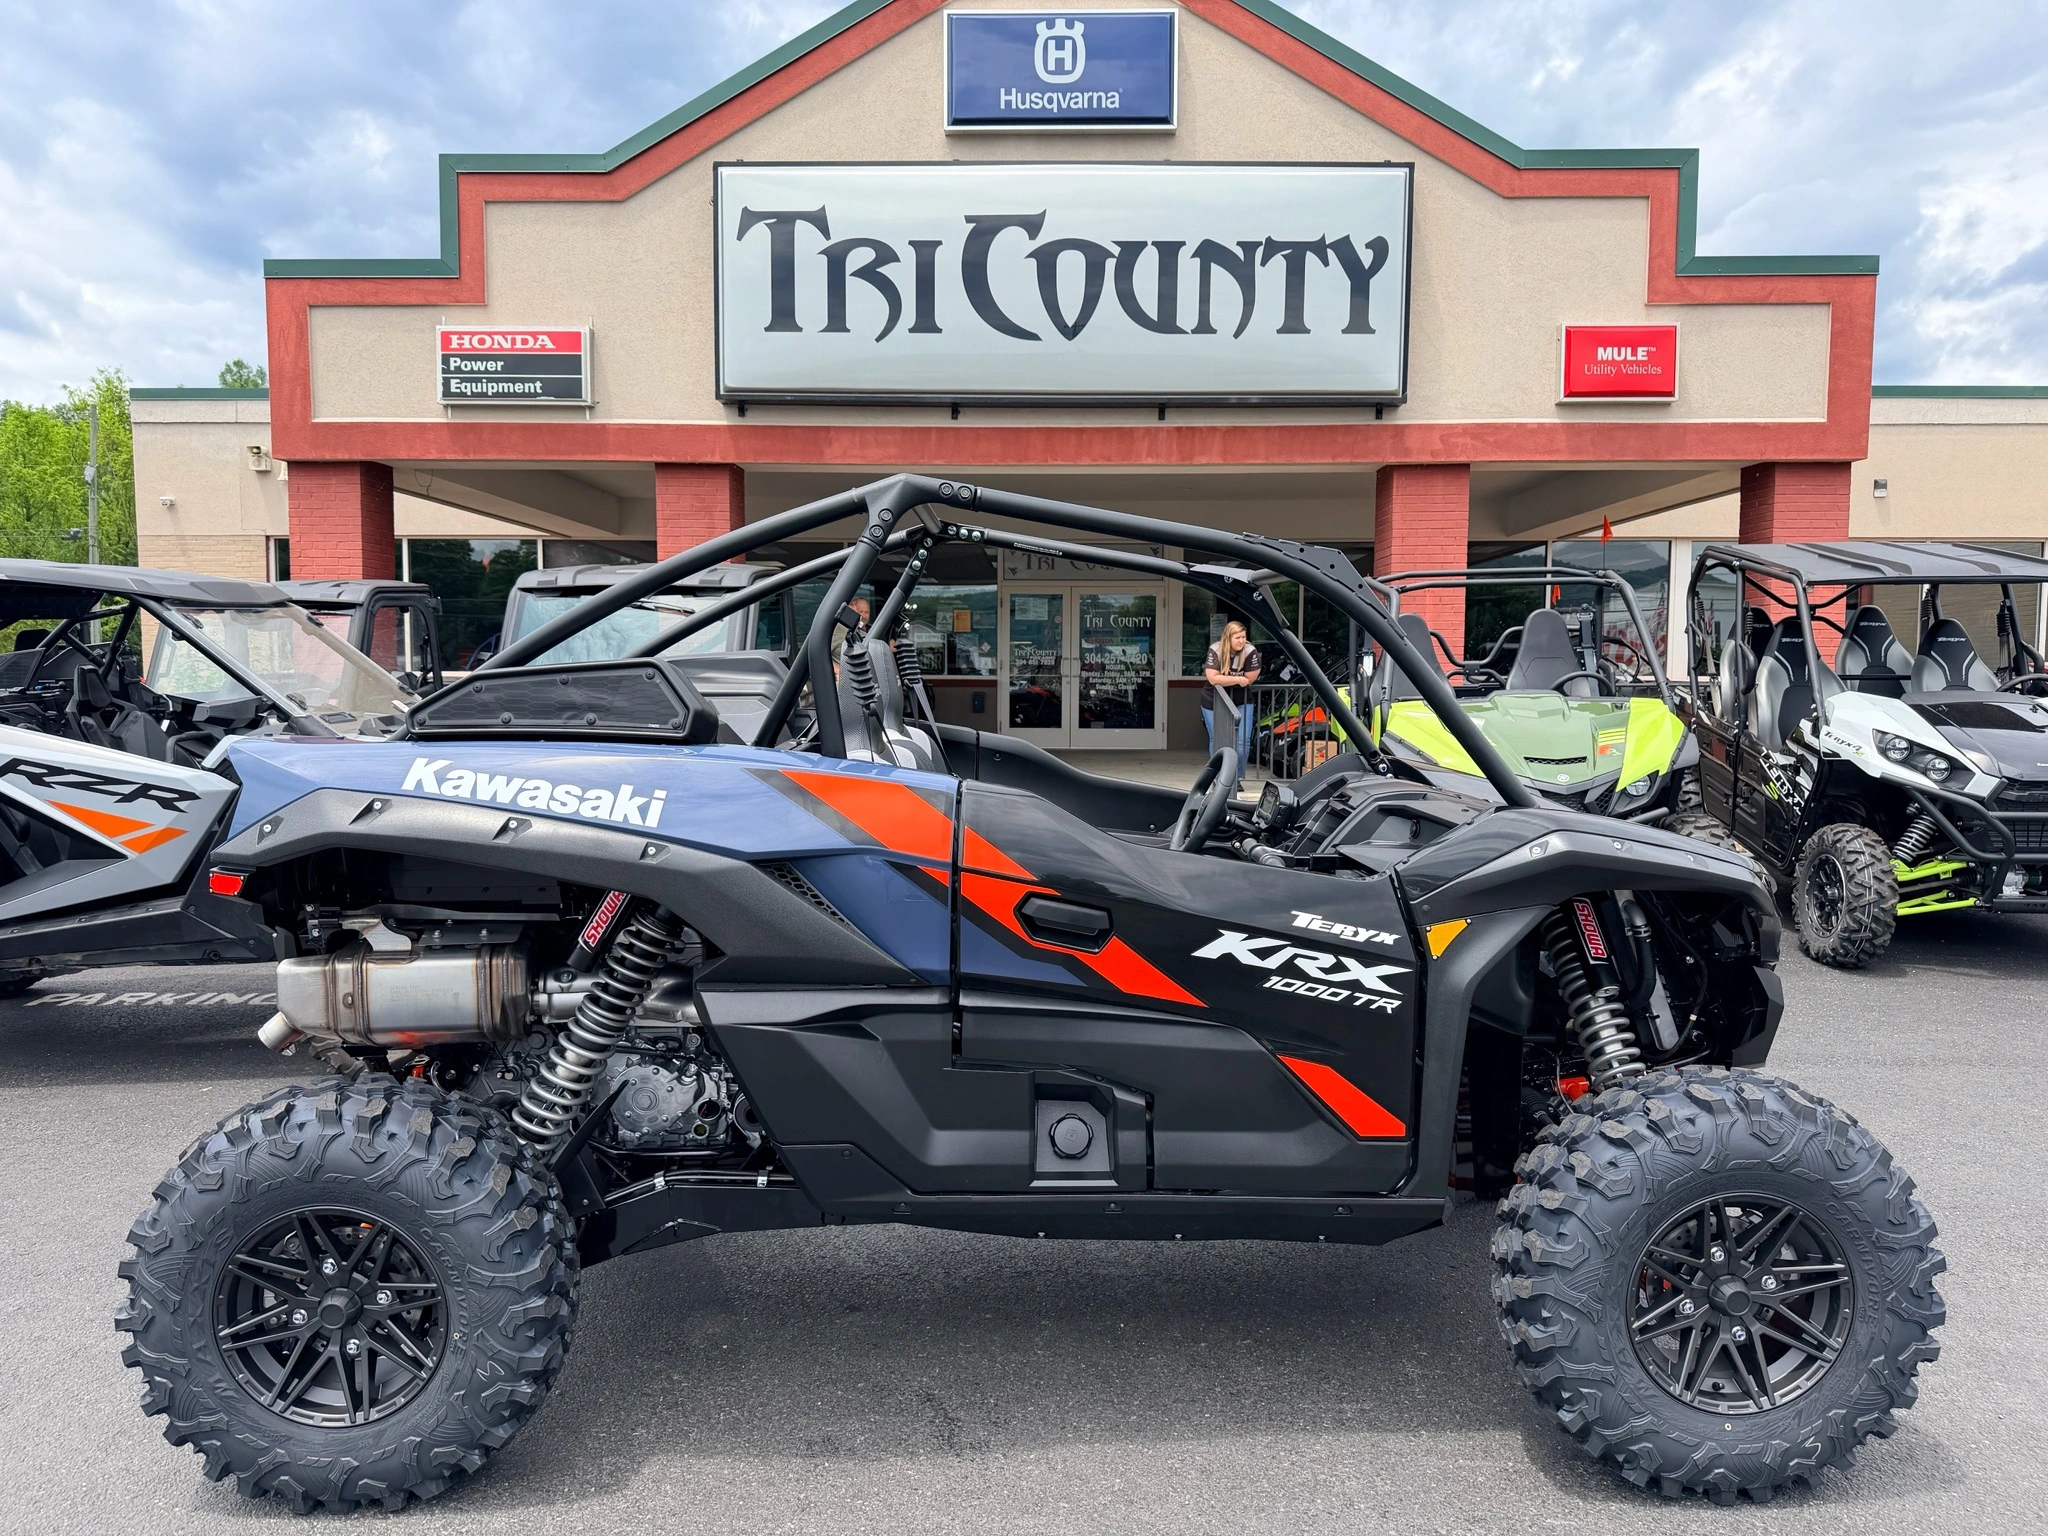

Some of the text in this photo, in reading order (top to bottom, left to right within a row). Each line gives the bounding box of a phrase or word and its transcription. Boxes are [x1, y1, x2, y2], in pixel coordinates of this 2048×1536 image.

[1000, 87, 1120, 113] Husqvarna
[736, 203, 1390, 344] TRI COUNTY
[449, 334, 556, 349] HONDA
[449, 357, 504, 371] Power
[450, 379, 542, 396] Equipment
[1584, 363, 1662, 377] Utility Vehicles
[0, 757, 202, 813] RZR
[401, 757, 667, 828] Kawasaki
[584, 890, 627, 947] SHOWA
[1290, 910, 1402, 945] TERYX
[1573, 902, 1607, 958] SHOWA
[1191, 929, 1414, 995] KRX
[420, 1227, 470, 1358] CARNIVORE
[1825, 1201, 1880, 1328] CARNIVORE
